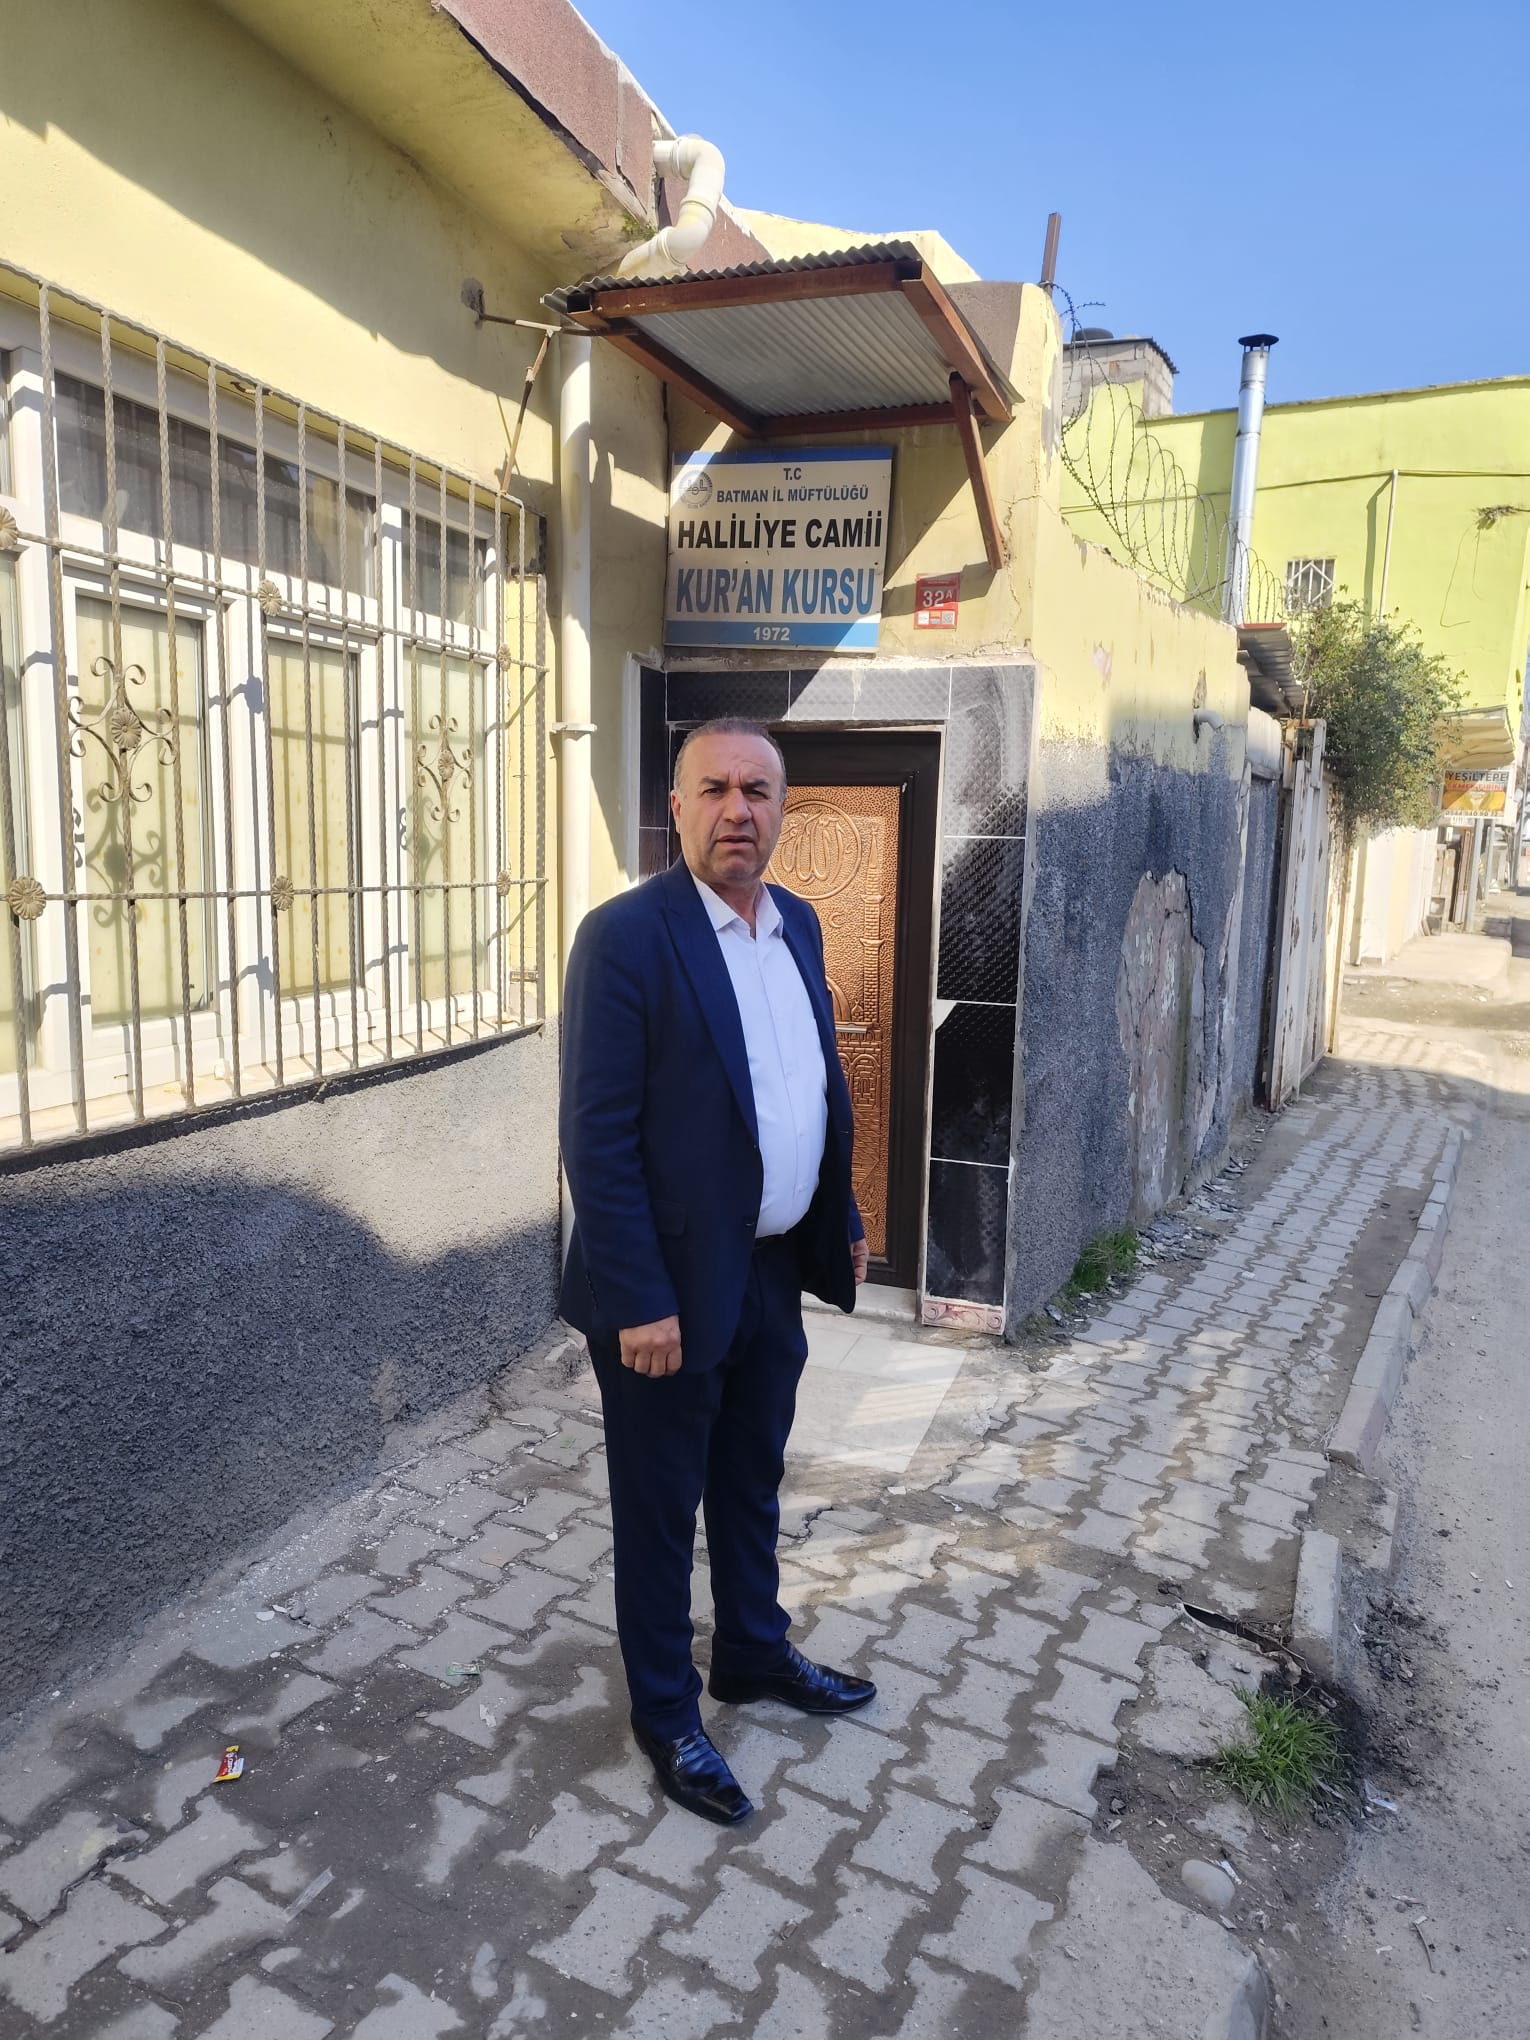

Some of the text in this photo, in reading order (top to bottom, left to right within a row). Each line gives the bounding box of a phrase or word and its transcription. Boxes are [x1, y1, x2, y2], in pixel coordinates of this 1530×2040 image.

[783, 467, 802, 481] T.C
[716, 484, 869, 503] BATMAN İL MÜFTÜLÜĞÜ
[677, 510, 882, 549] HALİLİYE CAMİİ
[781, 568, 875, 615] KURSU
[753, 627, 791, 641] 1972
